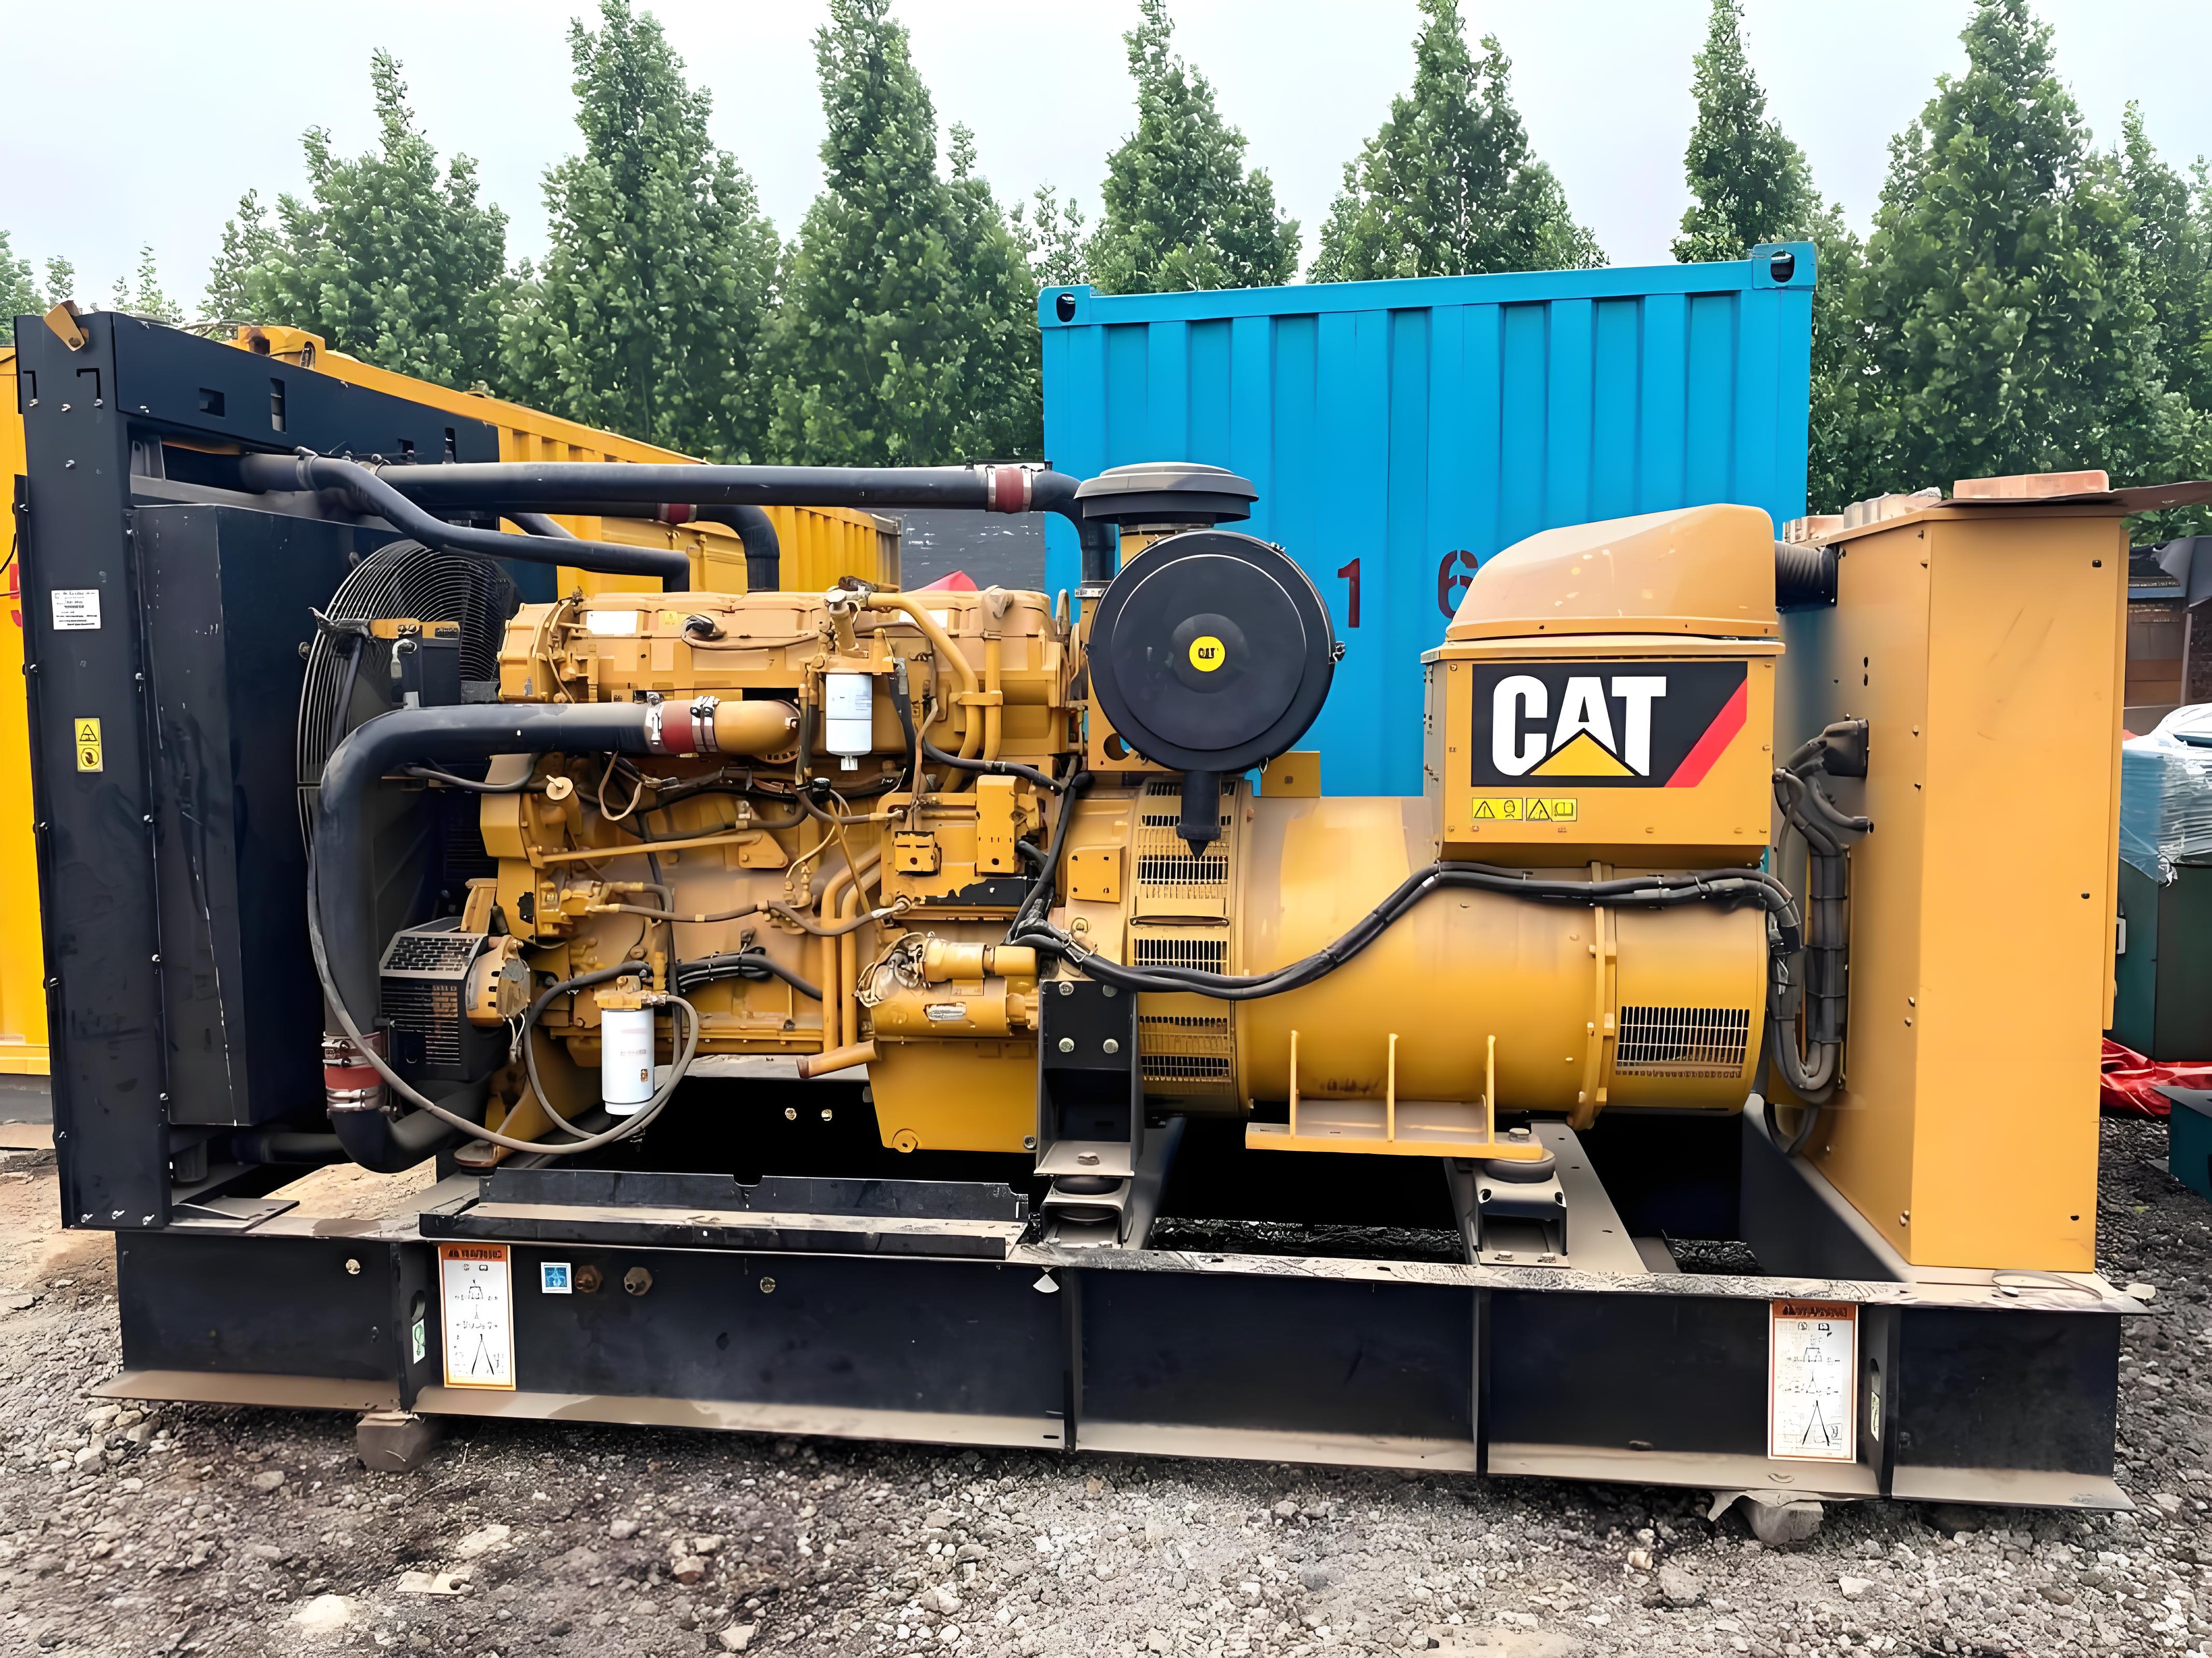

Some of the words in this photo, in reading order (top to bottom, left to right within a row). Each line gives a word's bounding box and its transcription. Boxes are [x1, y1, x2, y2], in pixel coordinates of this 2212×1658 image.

[1338, 558, 1360, 628] 1
[1438, 550, 1478, 619] 6
[1493, 675, 1666, 776] CAT
